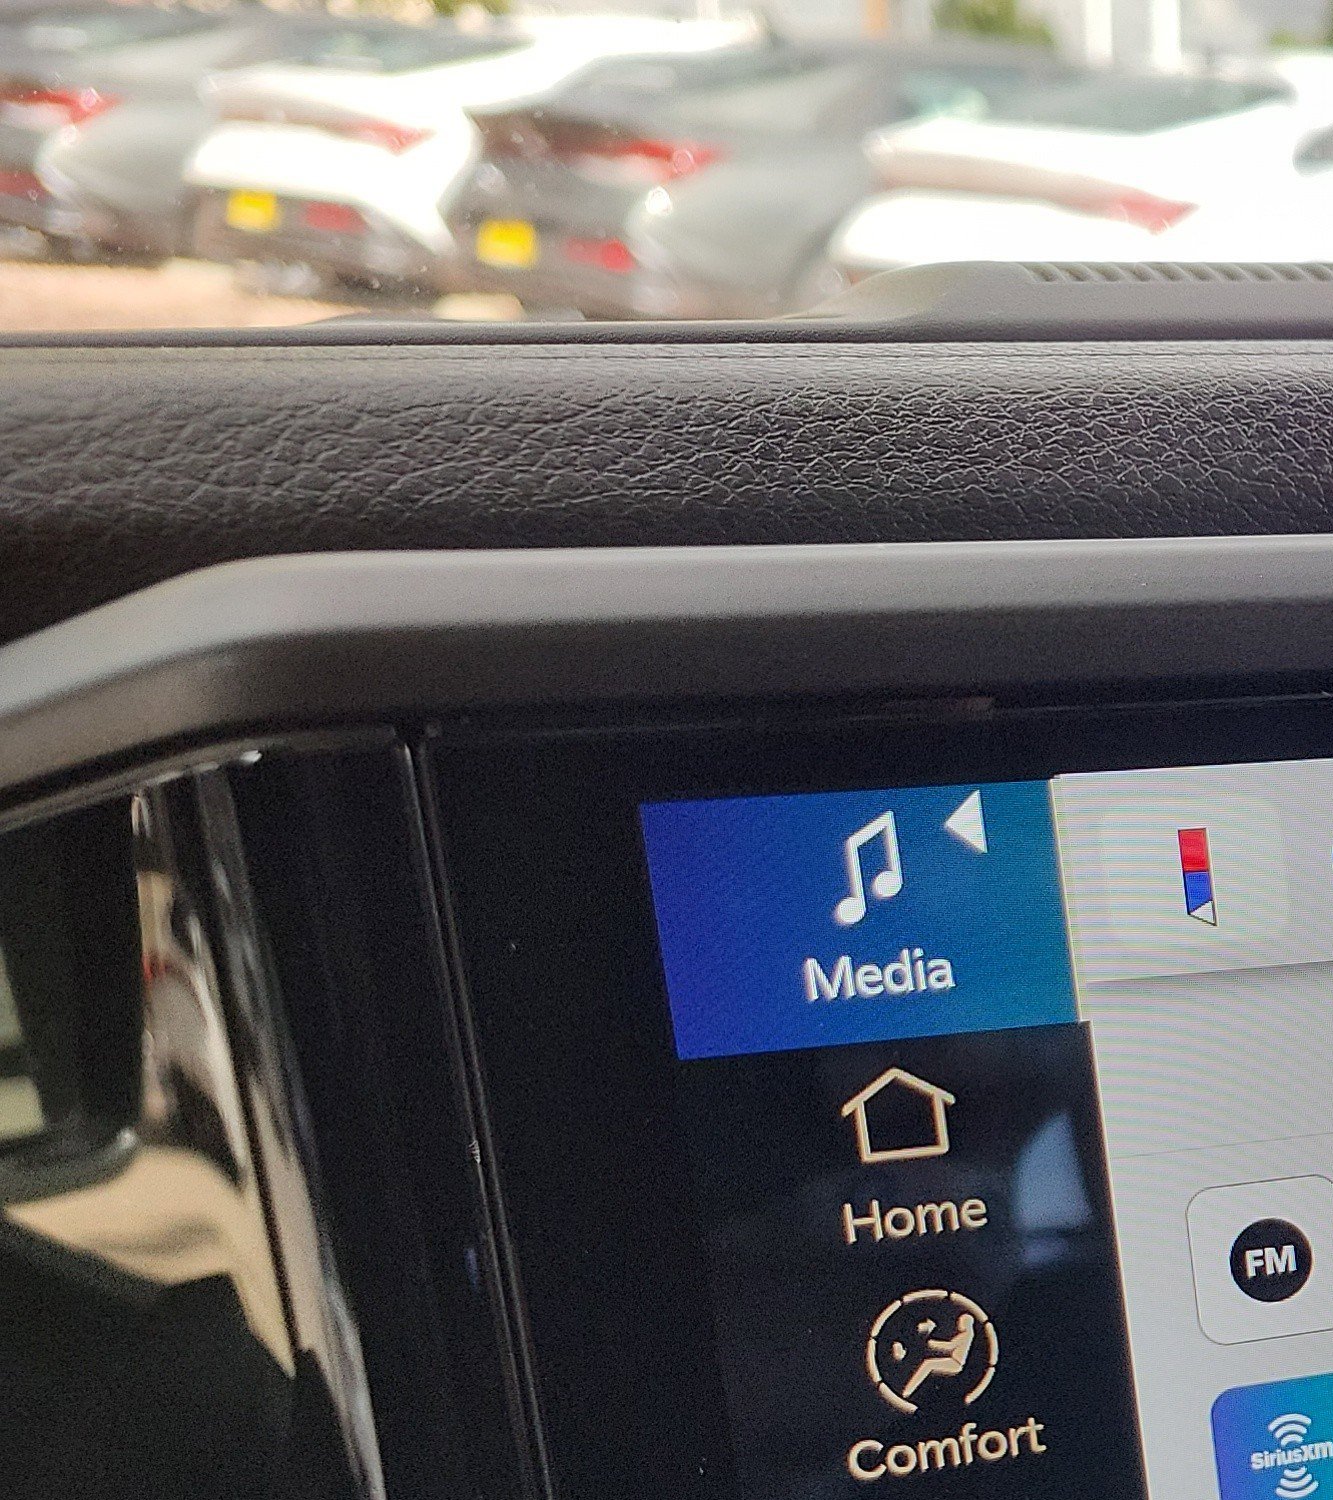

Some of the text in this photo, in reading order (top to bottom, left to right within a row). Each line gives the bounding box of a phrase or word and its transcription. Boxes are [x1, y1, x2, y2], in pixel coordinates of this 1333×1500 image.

[803, 948, 955, 1001] Media
[842, 1195, 988, 1244] Home
[1245, 1245, 1297, 1277] FM
[847, 1417, 1047, 1481] Comfort
